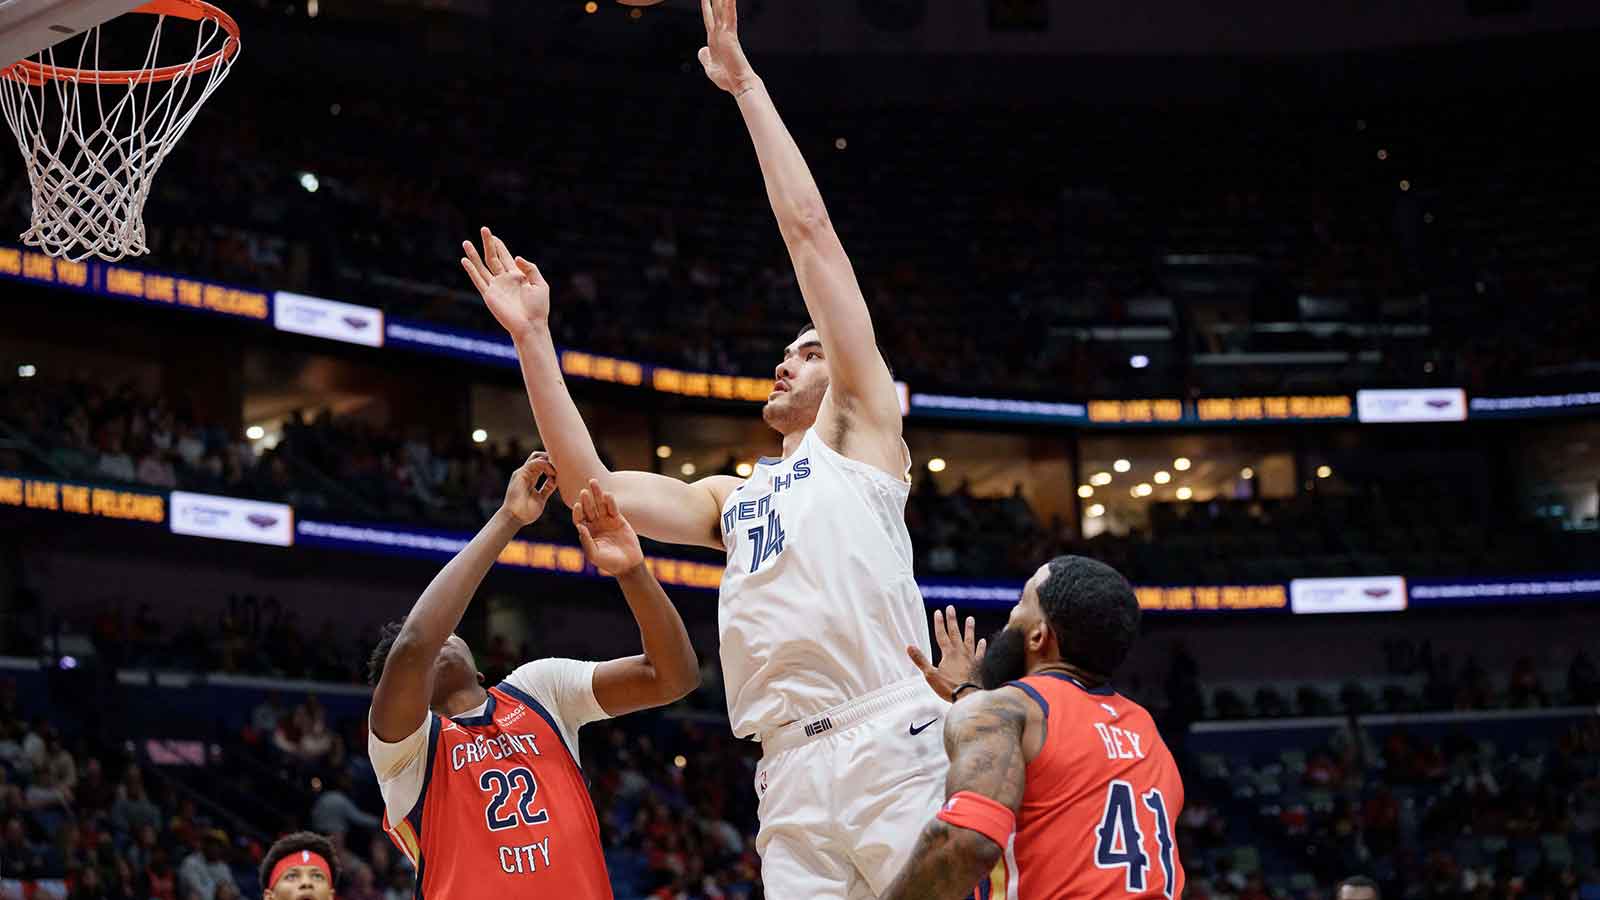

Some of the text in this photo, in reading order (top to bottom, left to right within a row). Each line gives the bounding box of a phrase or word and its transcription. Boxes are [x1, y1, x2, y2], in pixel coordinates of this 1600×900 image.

[723, 457, 811, 534] MEMHS
[748, 509, 785, 573] 14
[452, 732, 541, 771] CRECENT
[1094, 722, 1146, 759] BEY
[480, 767, 549, 832] 22
[499, 837, 551, 874] CITY
[1095, 780, 1175, 900] 41
